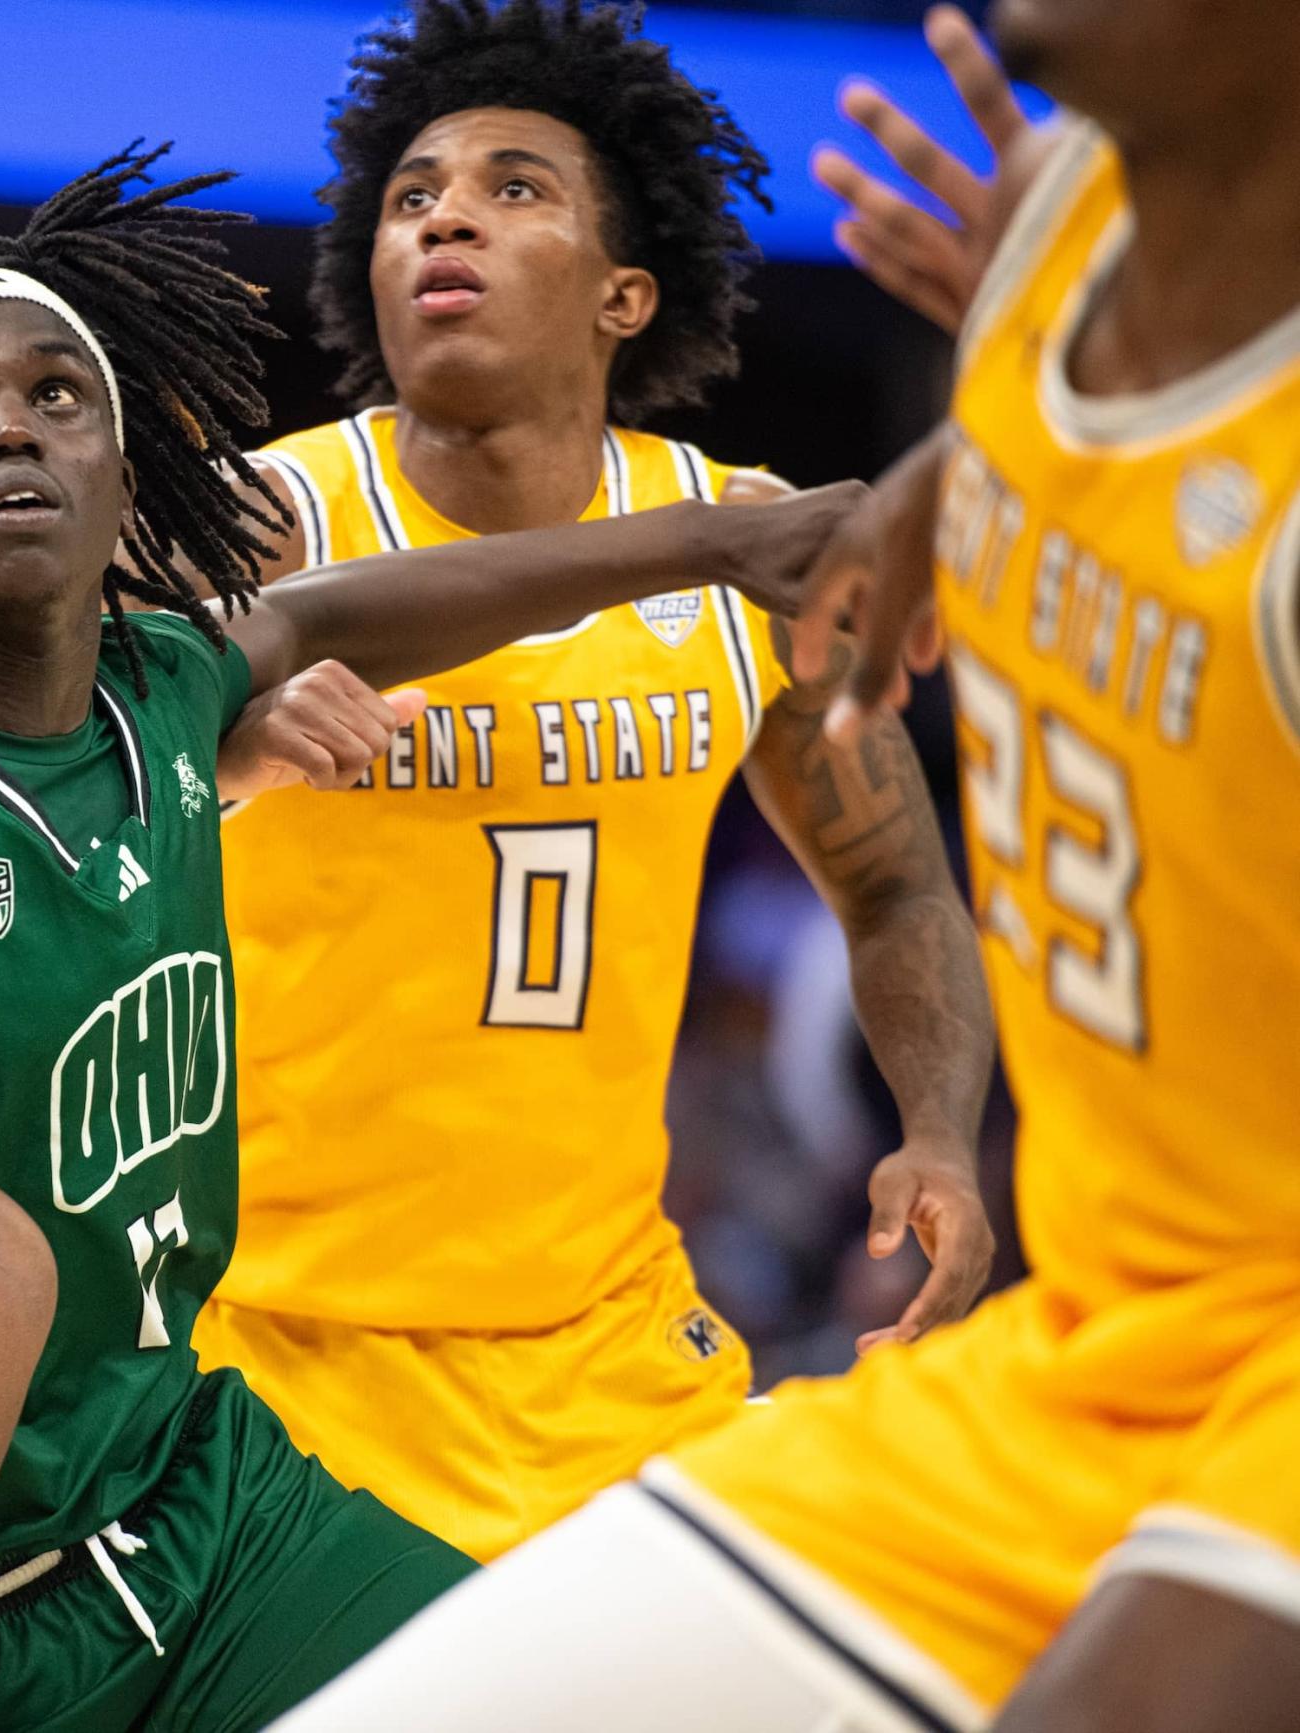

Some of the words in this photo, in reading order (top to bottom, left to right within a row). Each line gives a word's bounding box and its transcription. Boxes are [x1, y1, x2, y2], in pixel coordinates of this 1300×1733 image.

[351, 705, 496, 789] ENT
[533, 689, 712, 786] STATE
[479, 820, 598, 1031] 0
[50, 951, 227, 1214] OHIO
